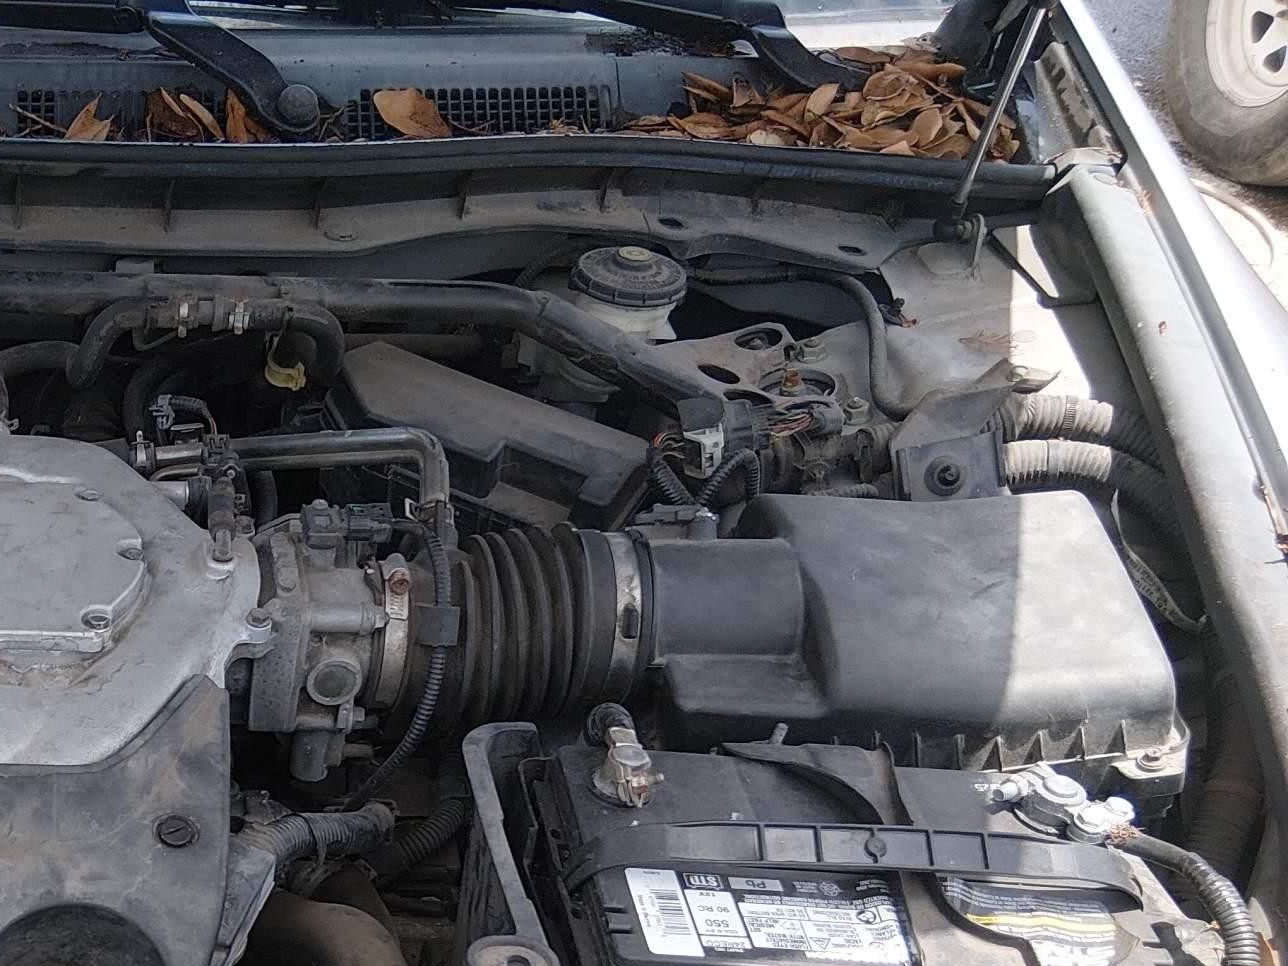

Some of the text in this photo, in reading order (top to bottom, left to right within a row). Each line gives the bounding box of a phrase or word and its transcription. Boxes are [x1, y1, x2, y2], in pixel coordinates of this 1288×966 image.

[745, 880, 767, 889] Pb
[698, 904, 730, 914] 90 RC
[704, 918, 730, 928] 550
